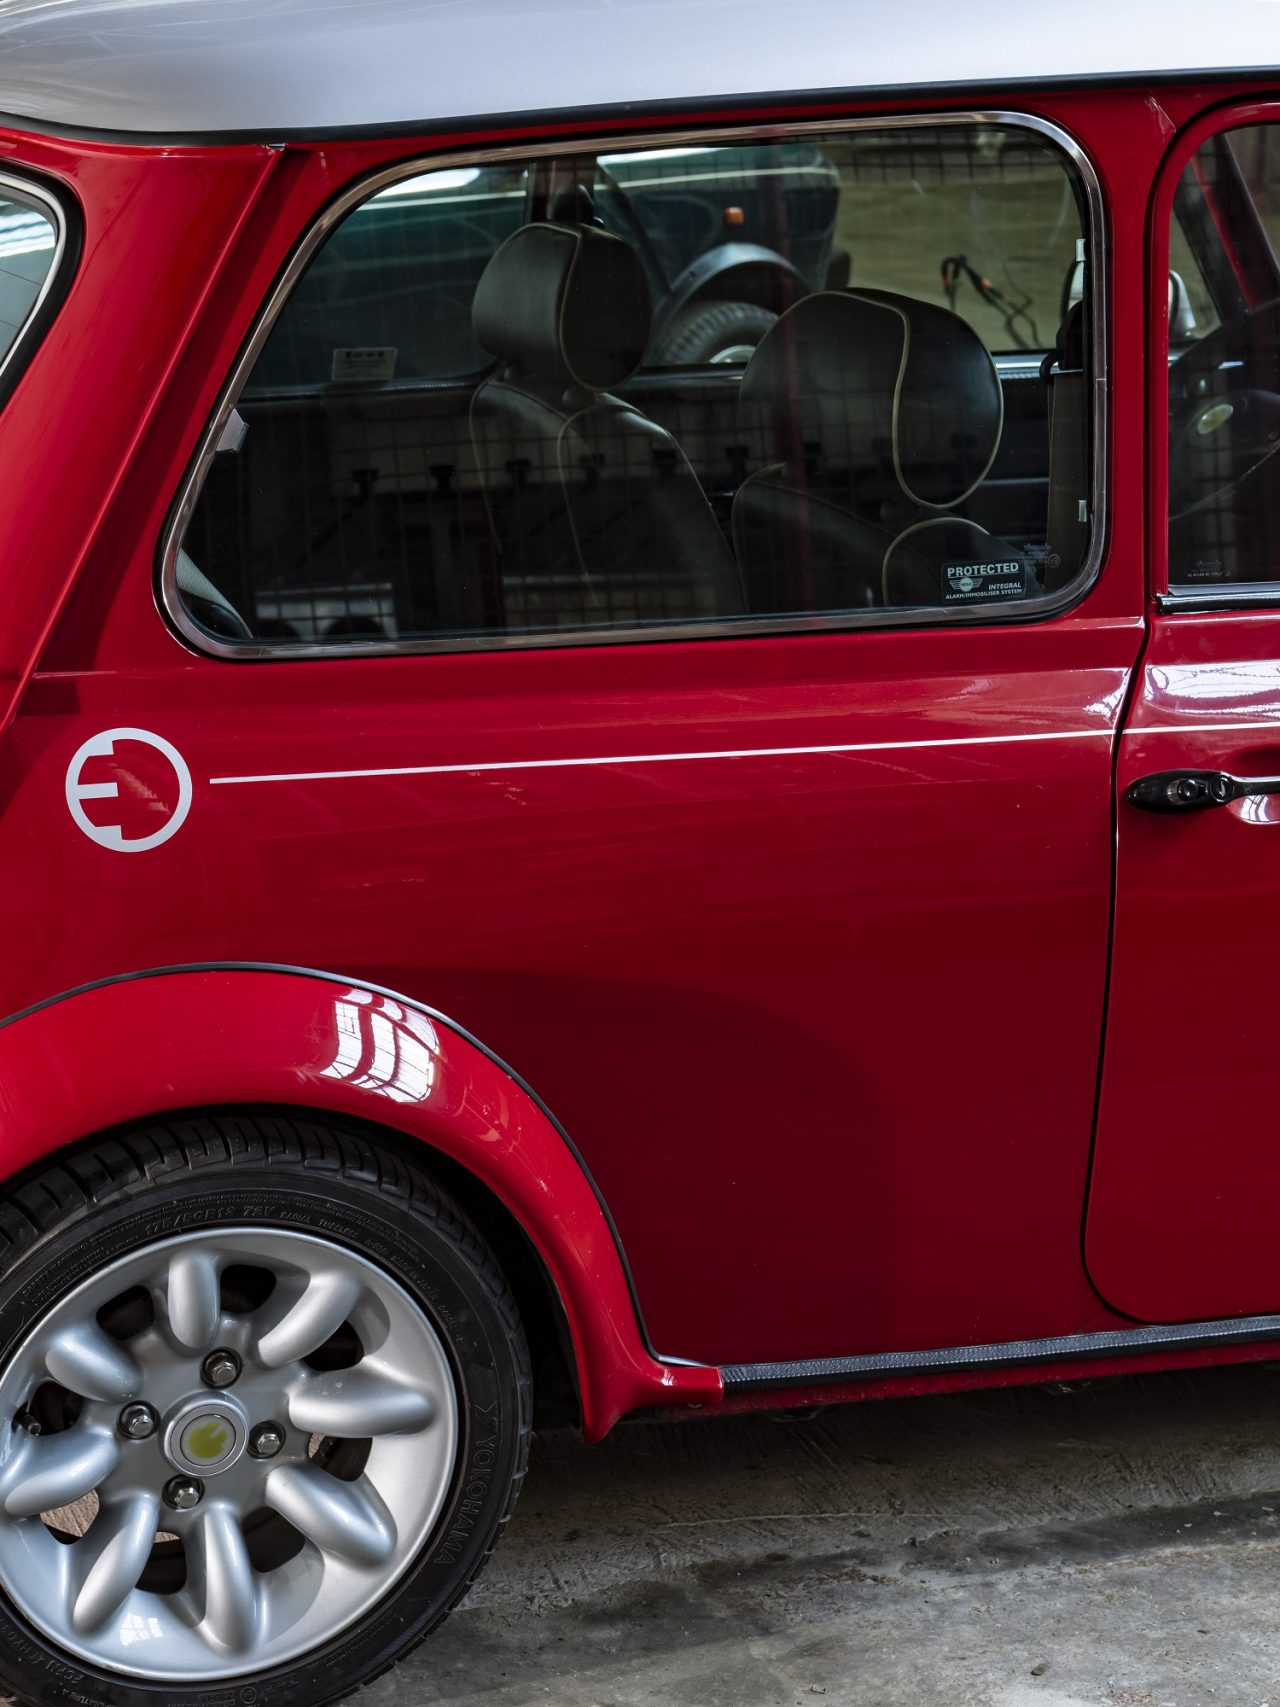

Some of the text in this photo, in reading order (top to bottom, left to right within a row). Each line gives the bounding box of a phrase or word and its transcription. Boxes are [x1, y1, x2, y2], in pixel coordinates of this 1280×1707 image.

[947, 563, 1019, 577] PROTECTED
[988, 582, 1021, 590] INTEGRAL
[433, 1435, 497, 1567] YOKOHAMA
